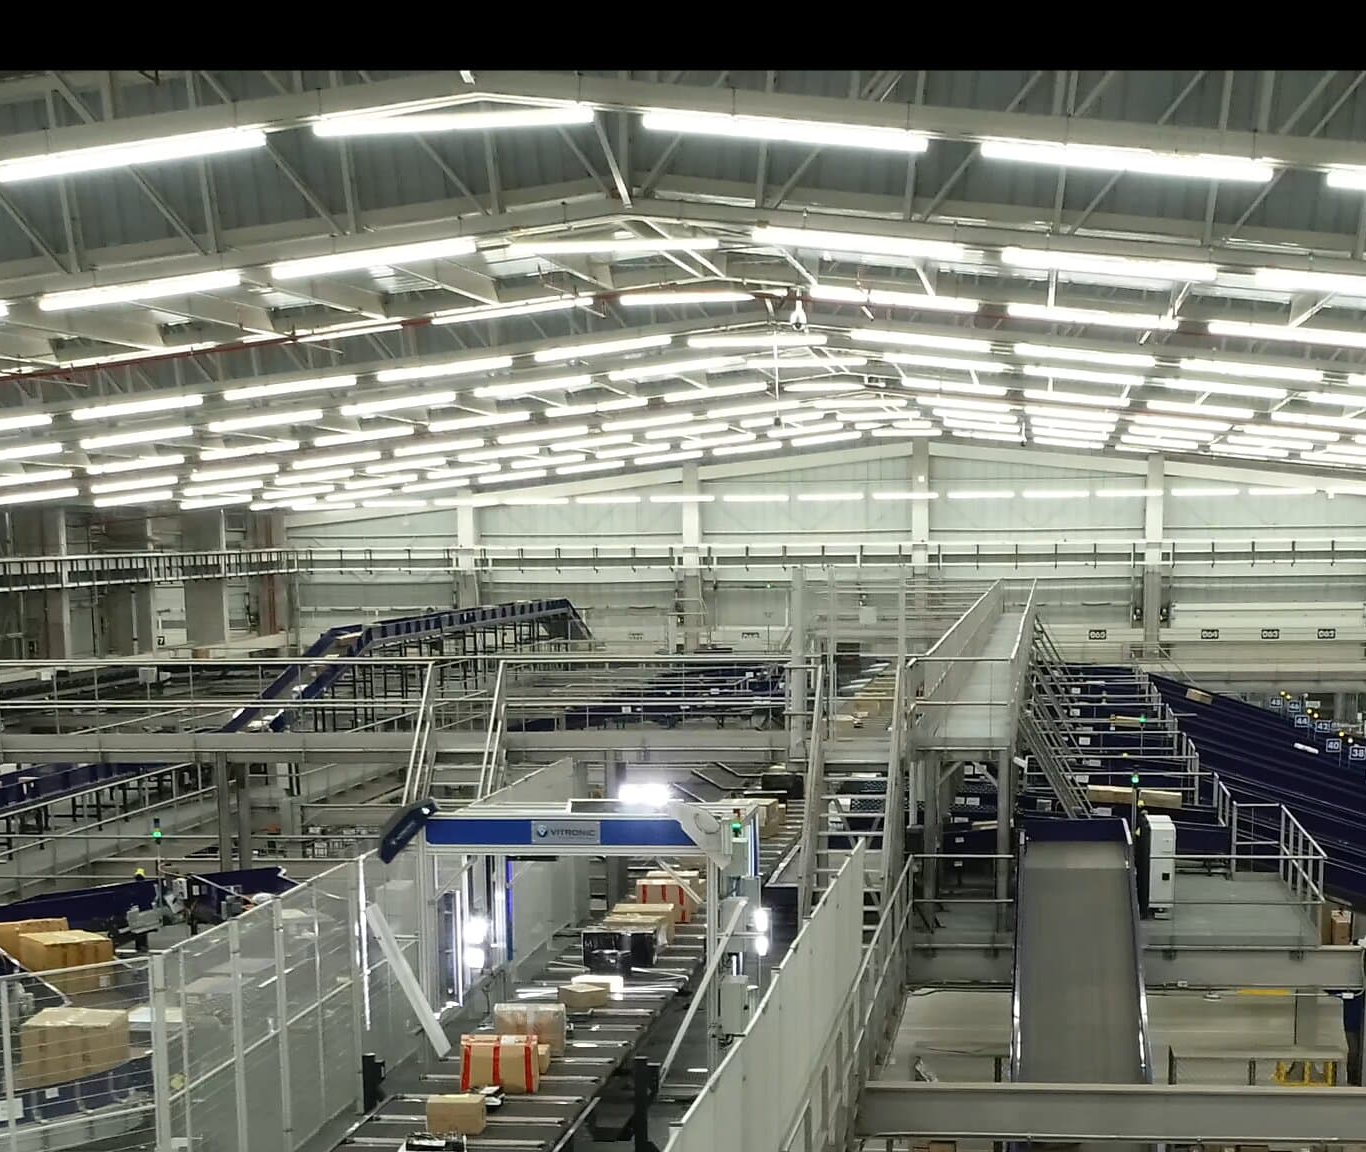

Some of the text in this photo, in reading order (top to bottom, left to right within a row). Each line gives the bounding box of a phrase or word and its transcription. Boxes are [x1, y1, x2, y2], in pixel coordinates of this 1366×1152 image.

[1328, 741, 1340, 750] 40
[1352, 749, 1365, 758] 38
[550, 829, 596, 837] VITRONIC
